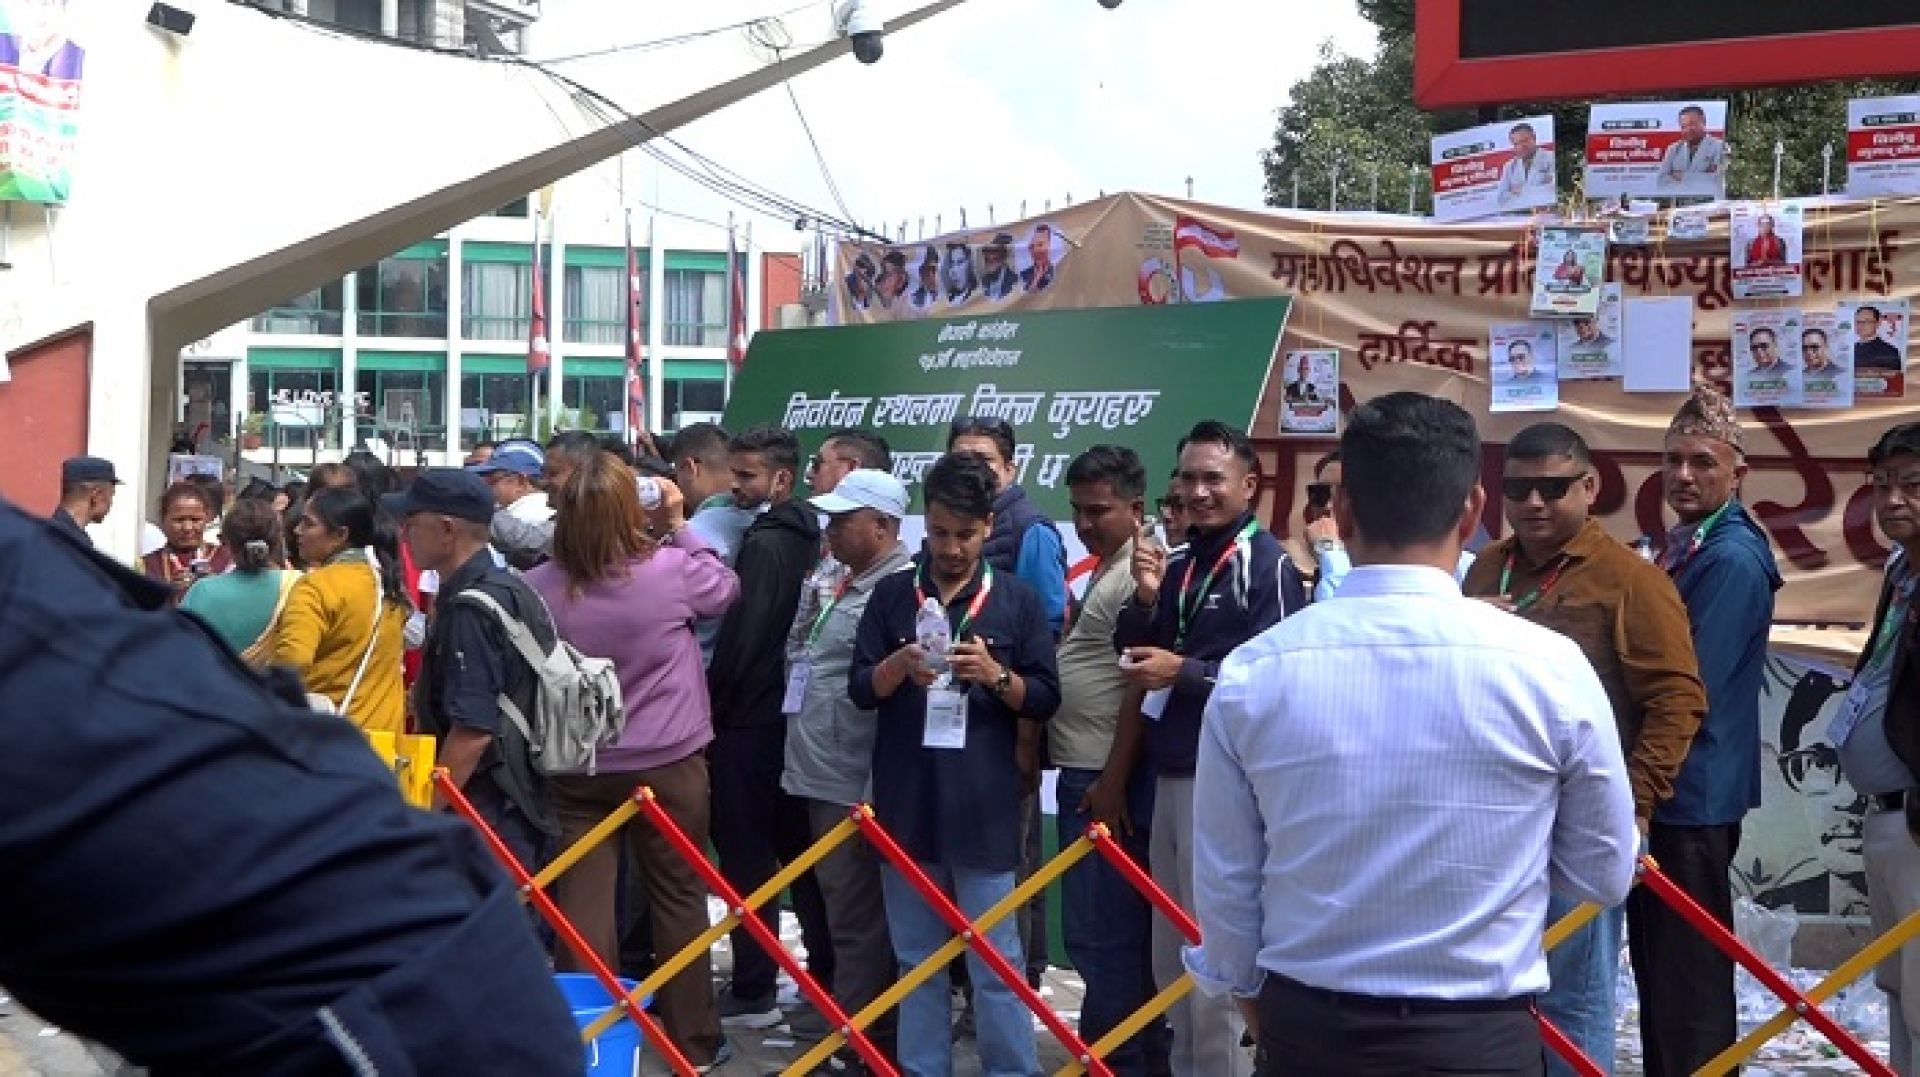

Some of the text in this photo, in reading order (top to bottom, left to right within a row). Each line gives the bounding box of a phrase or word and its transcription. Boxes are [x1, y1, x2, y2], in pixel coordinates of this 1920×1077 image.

[1270, 238, 1466, 296] महाधिवेशन
[1357, 320, 1479, 375] हार्दिक
[781, 389, 873, 430] निर्वाचन
[872, 393, 966, 428] स्थलमा
